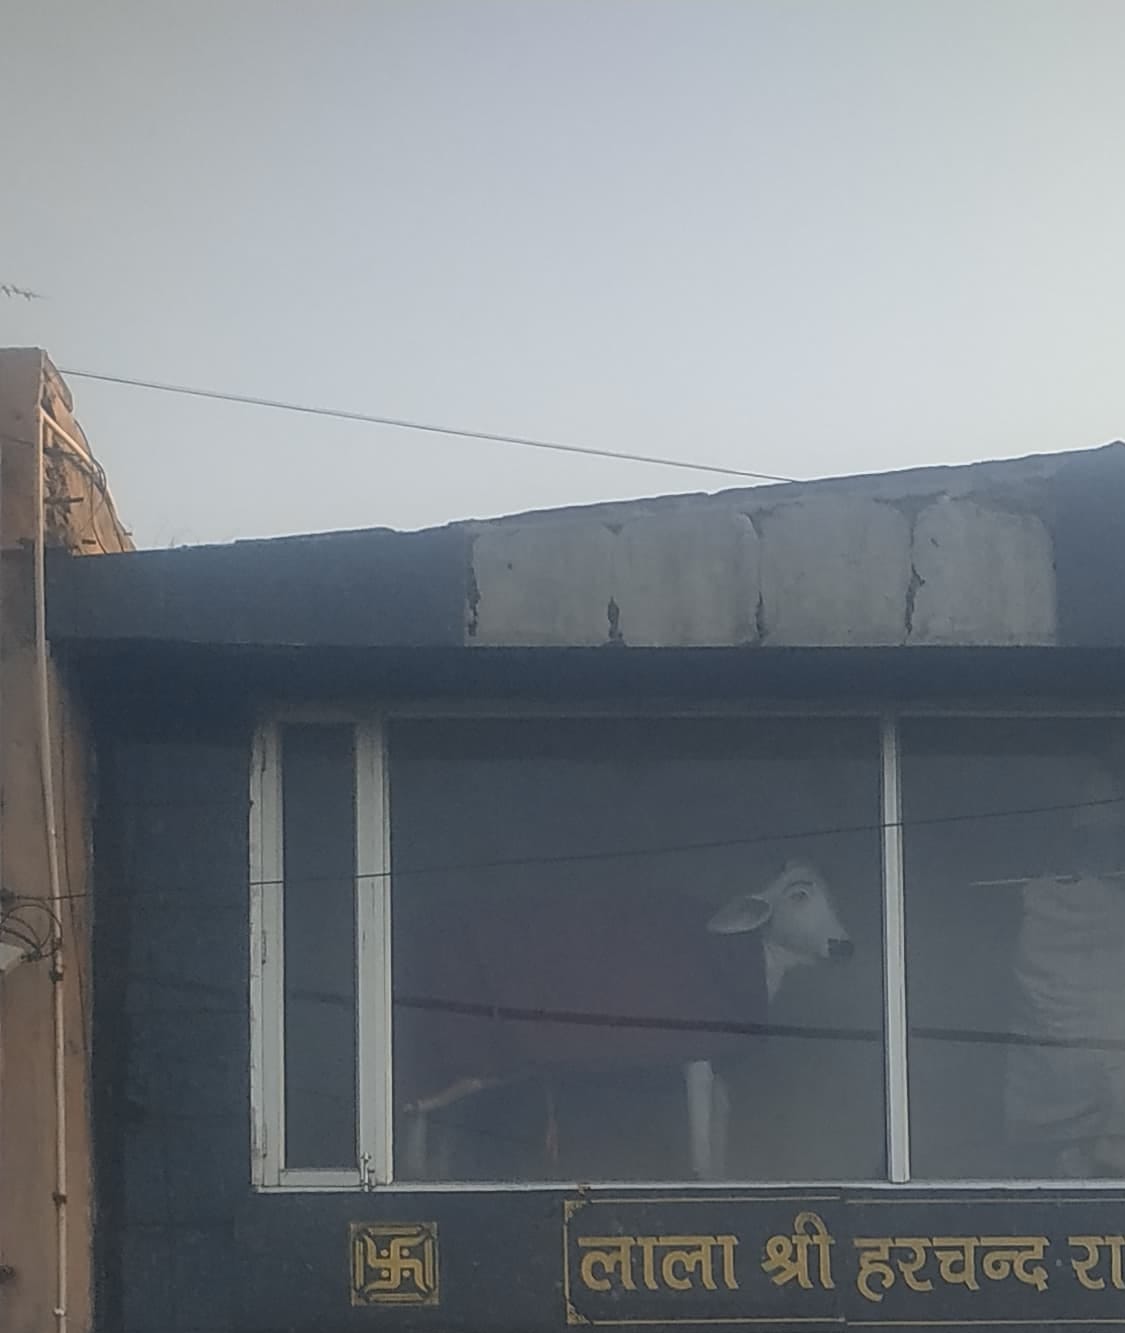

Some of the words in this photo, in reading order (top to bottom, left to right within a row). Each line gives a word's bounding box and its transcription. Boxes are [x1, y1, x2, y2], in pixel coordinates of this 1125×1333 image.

[578, 1235, 739, 1291] लाला
[761, 1212, 836, 1289] श्री
[854, 1235, 1050, 1301] हरचन्द
